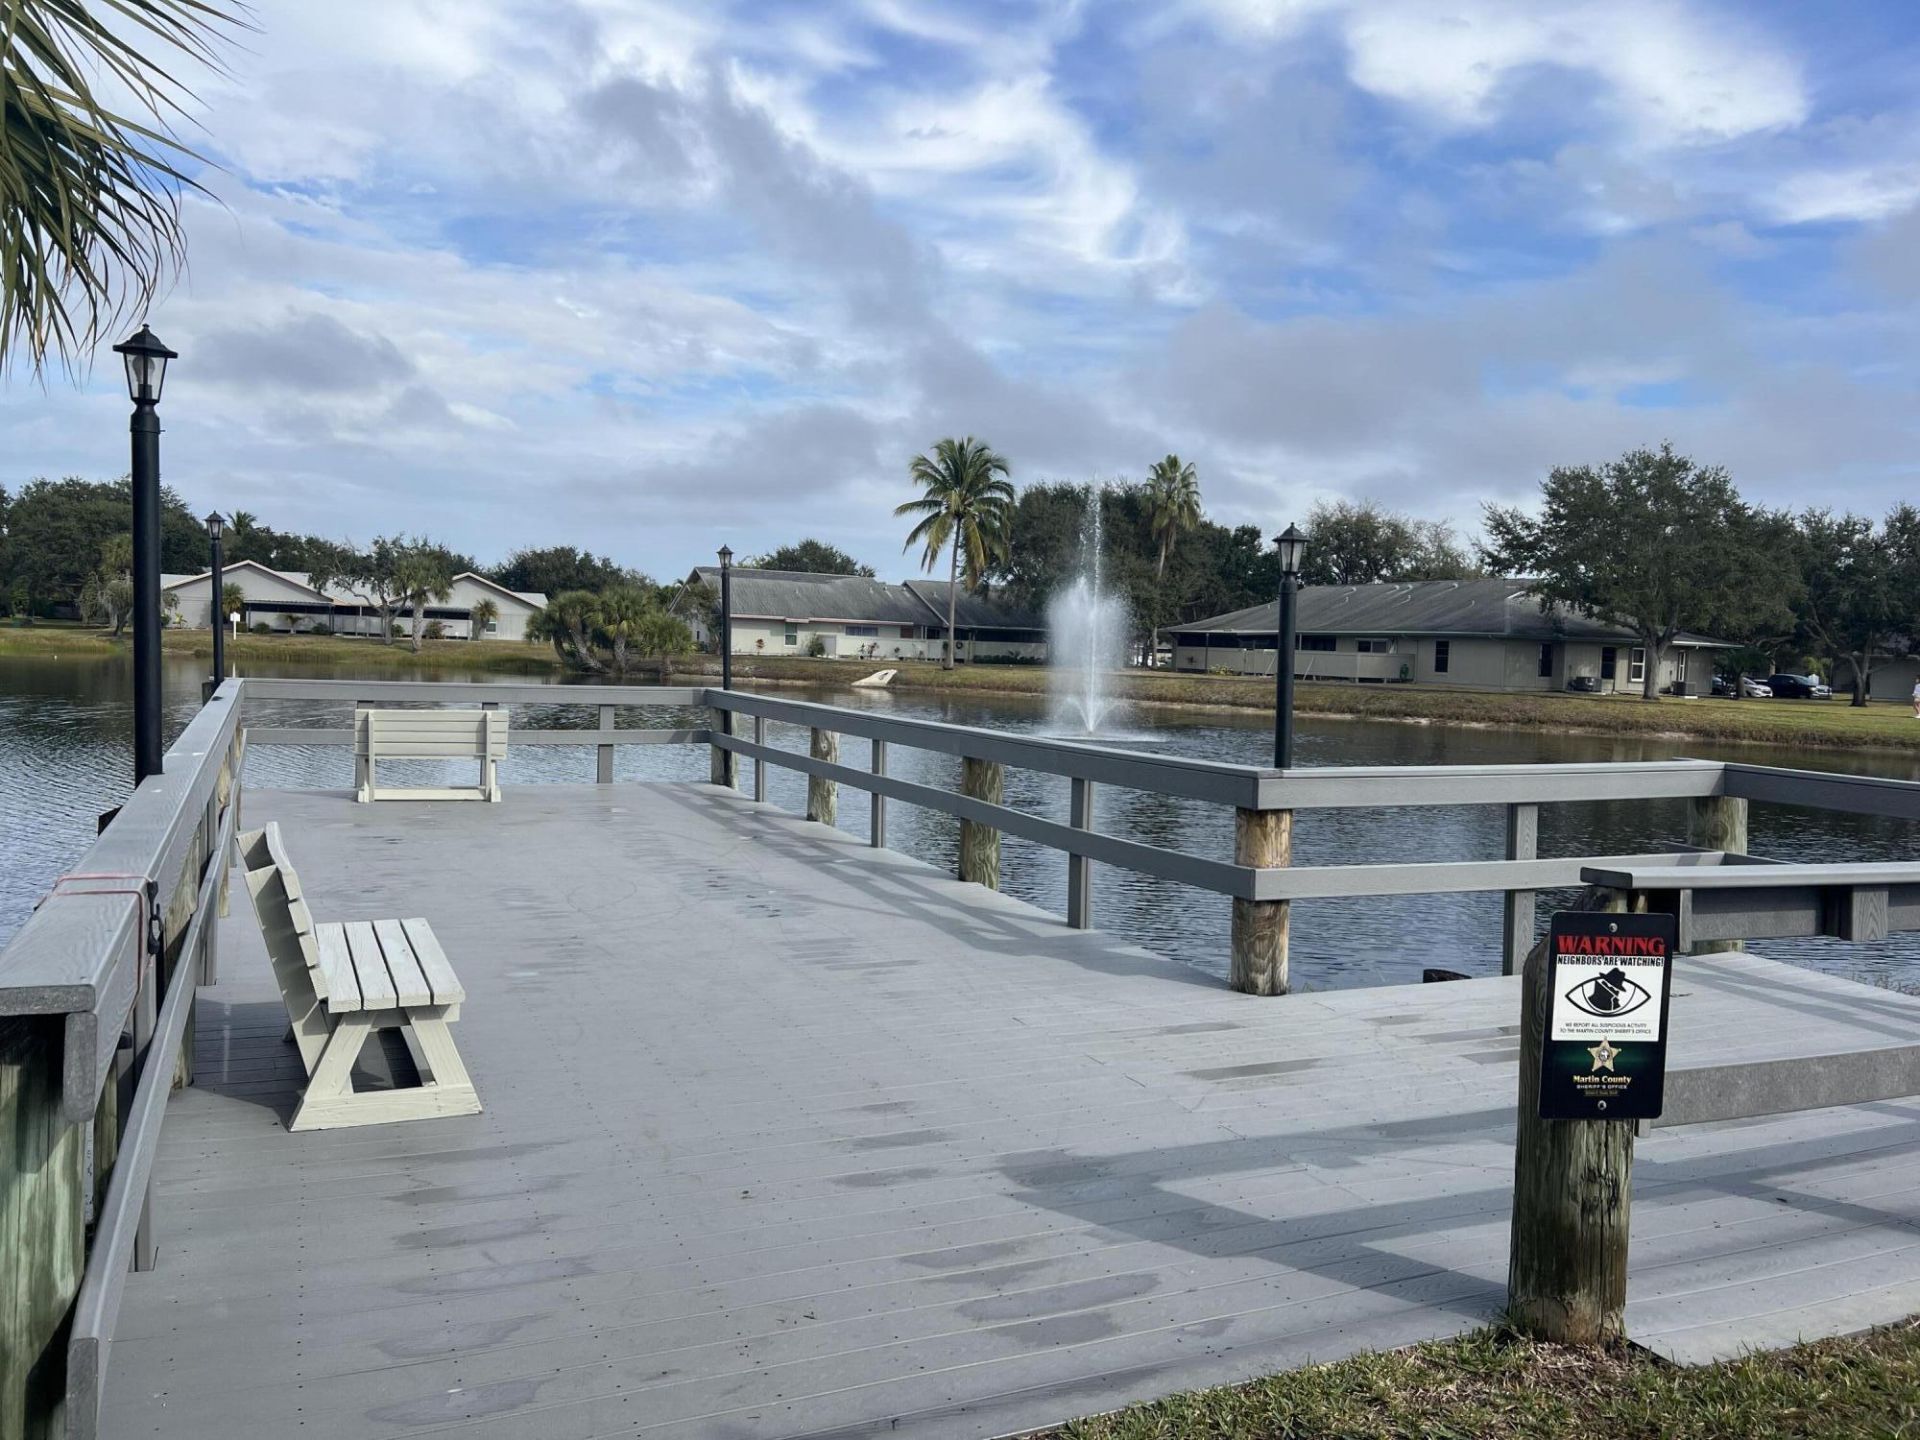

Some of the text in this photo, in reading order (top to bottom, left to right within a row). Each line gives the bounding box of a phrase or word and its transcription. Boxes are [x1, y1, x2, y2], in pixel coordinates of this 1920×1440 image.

[1558, 935, 1665, 955] WARNING
[1557, 955, 1664, 967] NEIGHBORS ARE WATCHING!
[1573, 1075, 1632, 1086] Martin County
